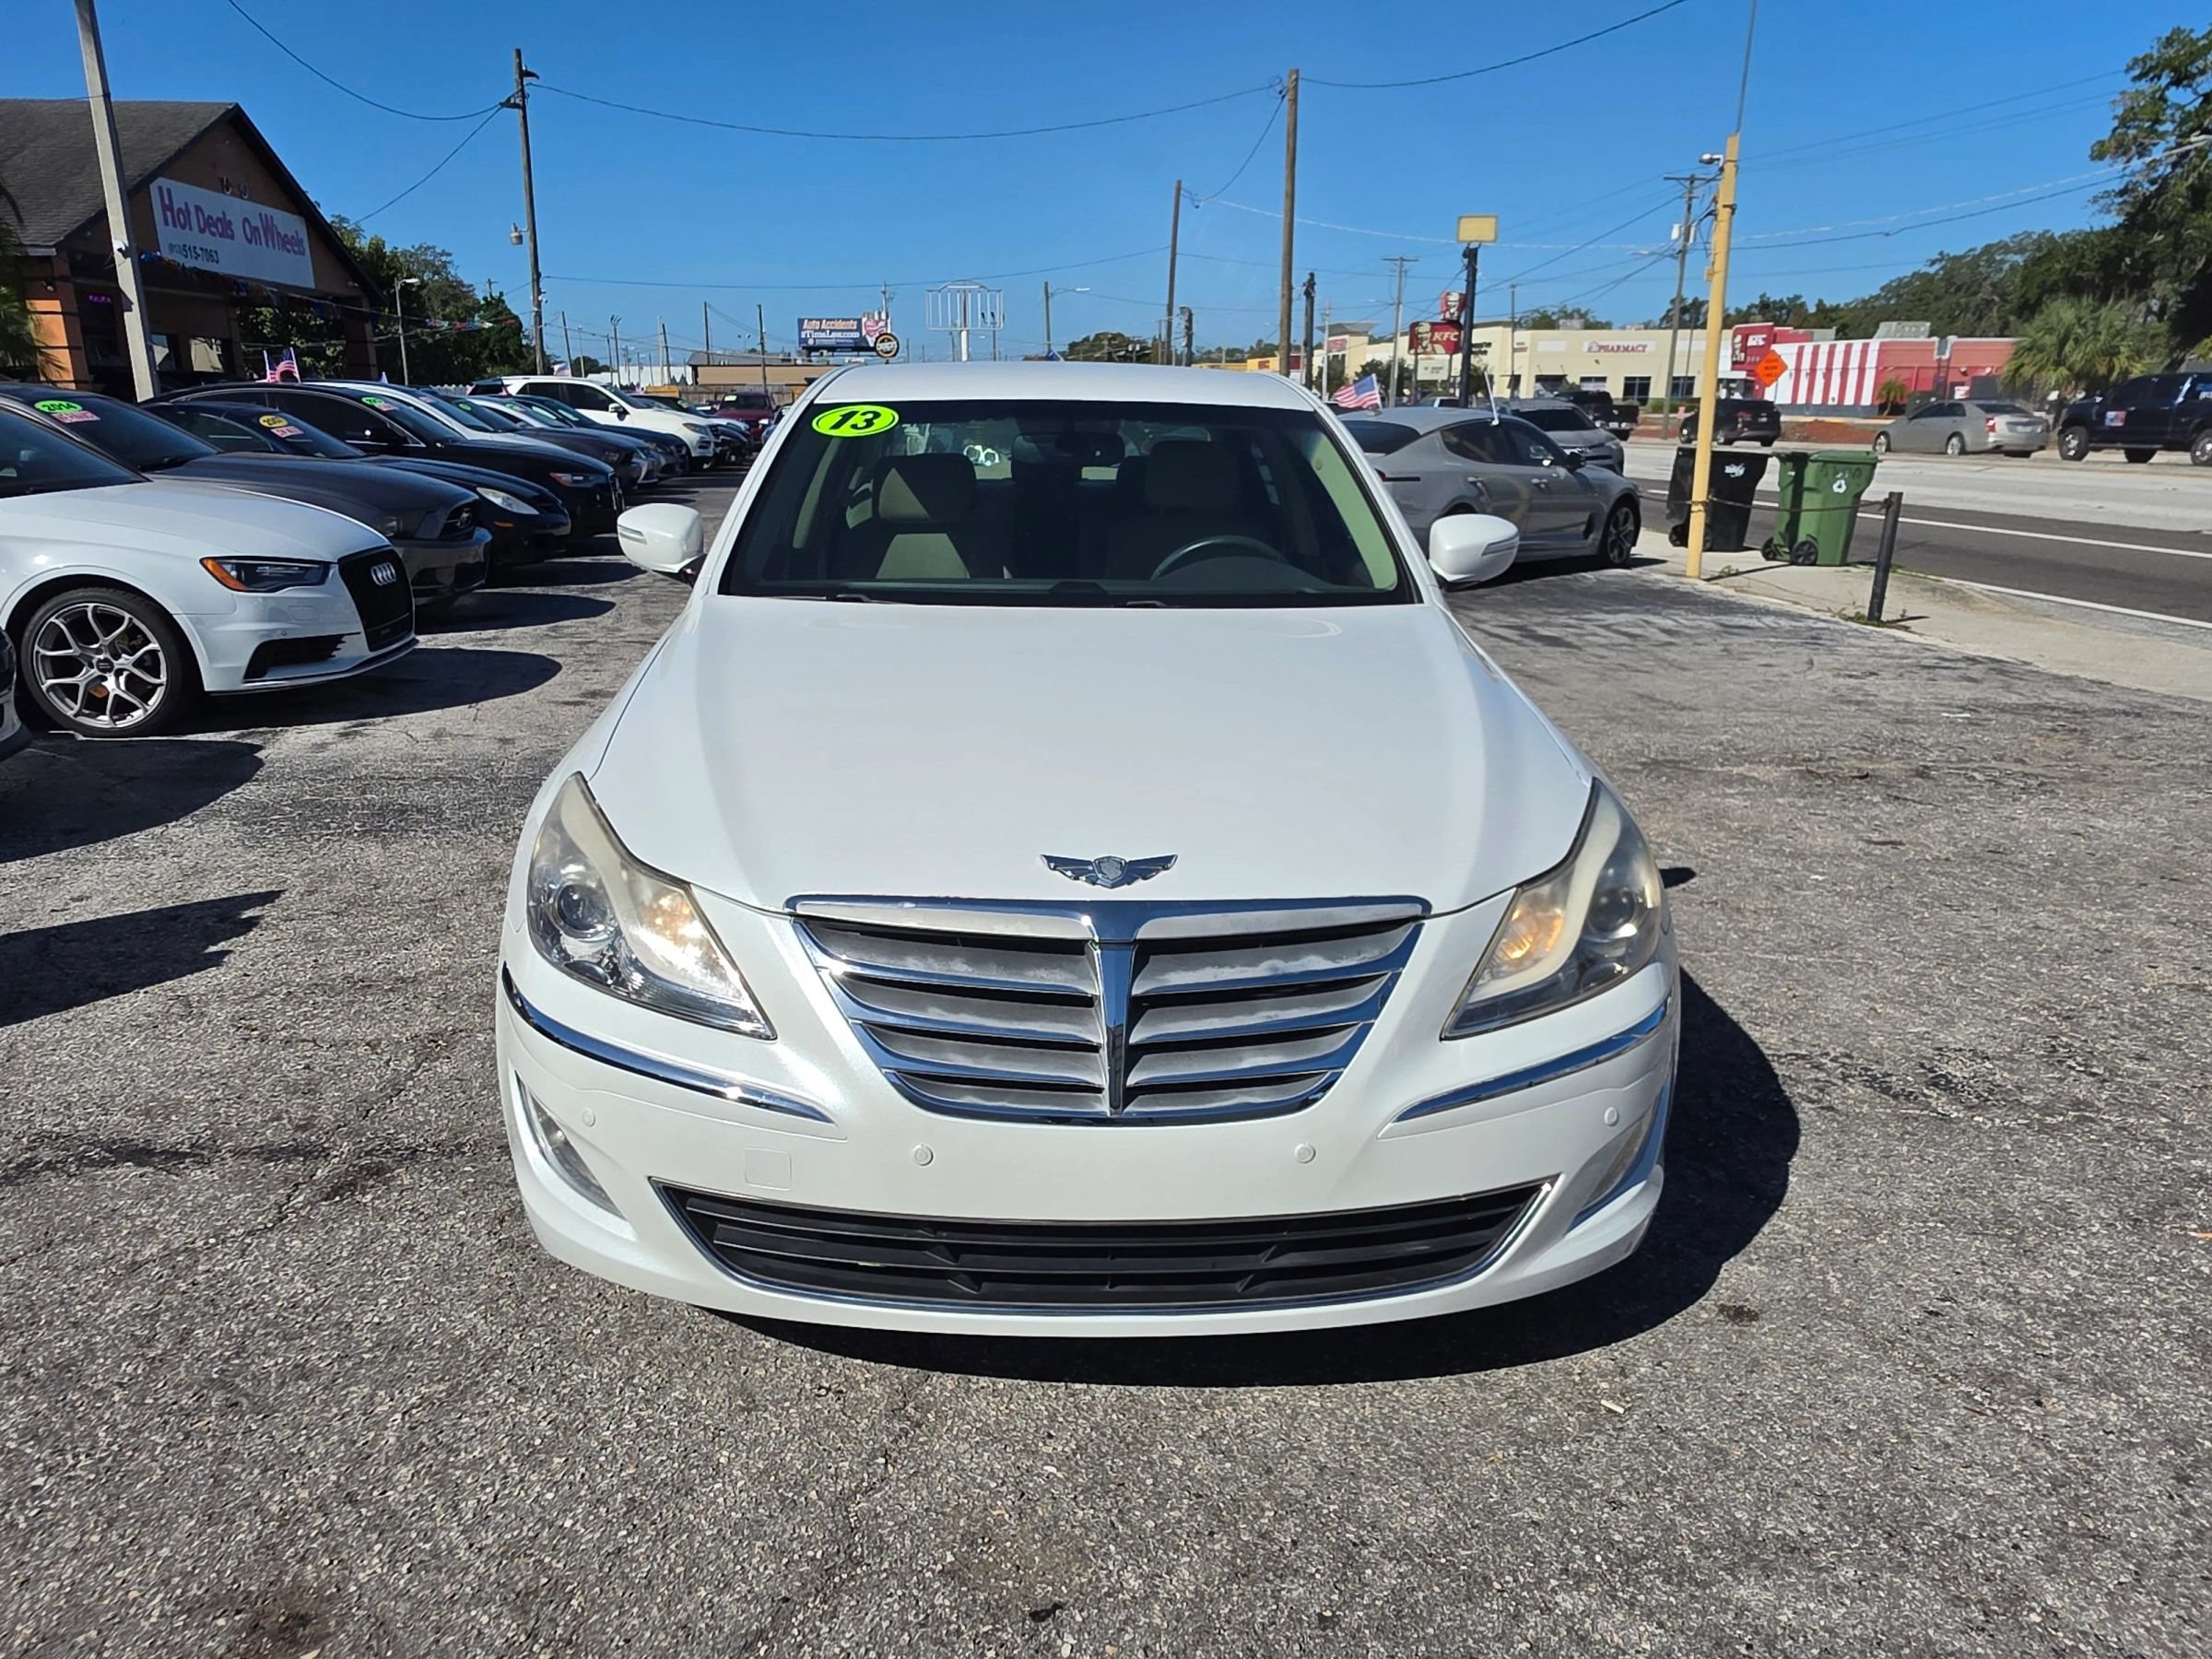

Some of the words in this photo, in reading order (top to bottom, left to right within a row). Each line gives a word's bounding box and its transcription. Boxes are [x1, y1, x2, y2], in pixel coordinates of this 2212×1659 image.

[158, 186, 193, 231] Hot
[194, 204, 236, 241] Deals
[241, 217, 263, 247] On
[259, 212, 306, 257] Wheels
[803, 319, 819, 330] Auto
[821, 319, 857, 330] Accidents
[1432, 331, 1459, 341] KFC
[1598, 344, 1648, 353] PHARMACY
[829, 410, 882, 430] 13
